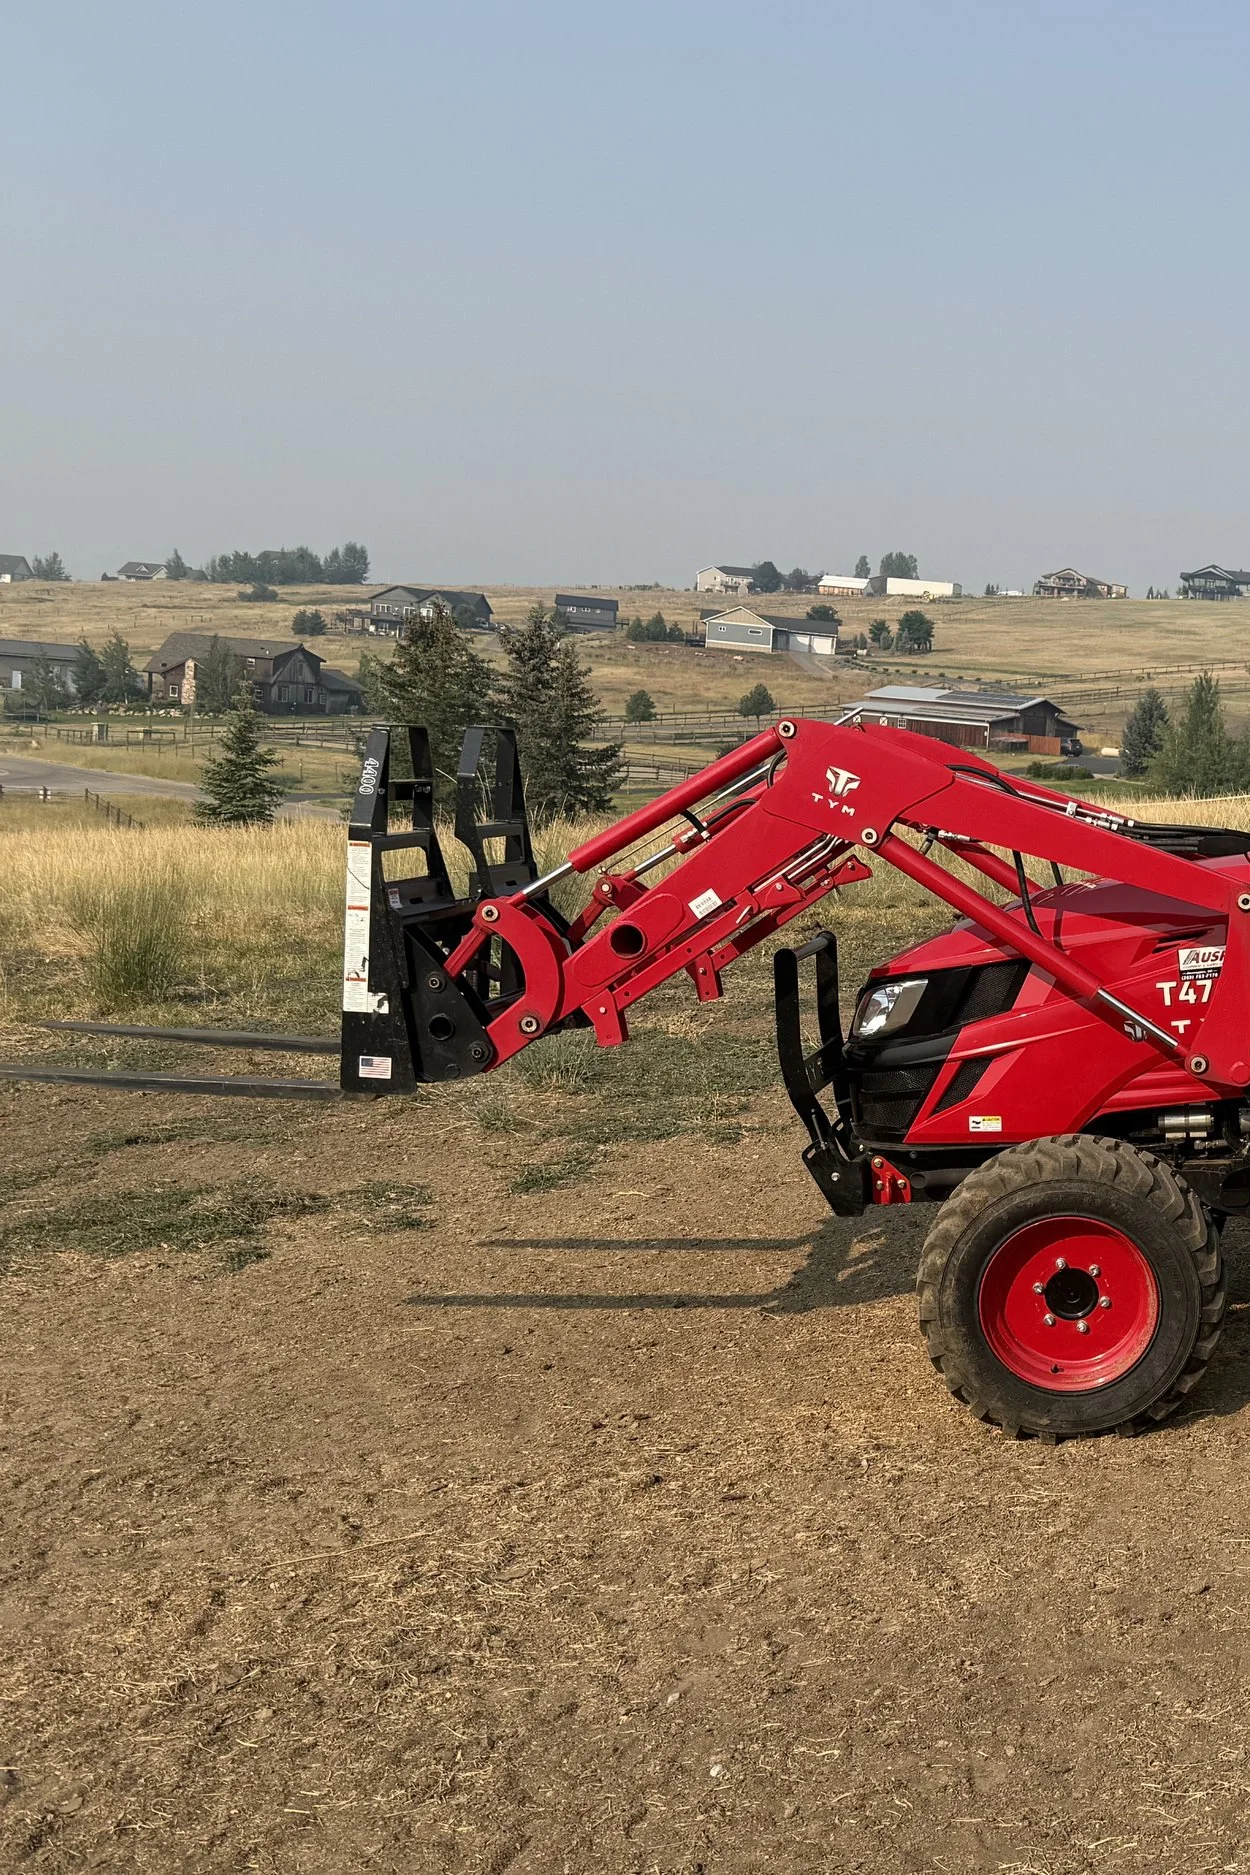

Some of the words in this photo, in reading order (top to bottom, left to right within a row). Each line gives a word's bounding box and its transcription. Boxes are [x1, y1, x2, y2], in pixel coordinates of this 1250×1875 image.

[359, 757, 379, 795] 4400
[811, 792, 856, 817] TYM
[1155, 979, 1213, 1006] T47
